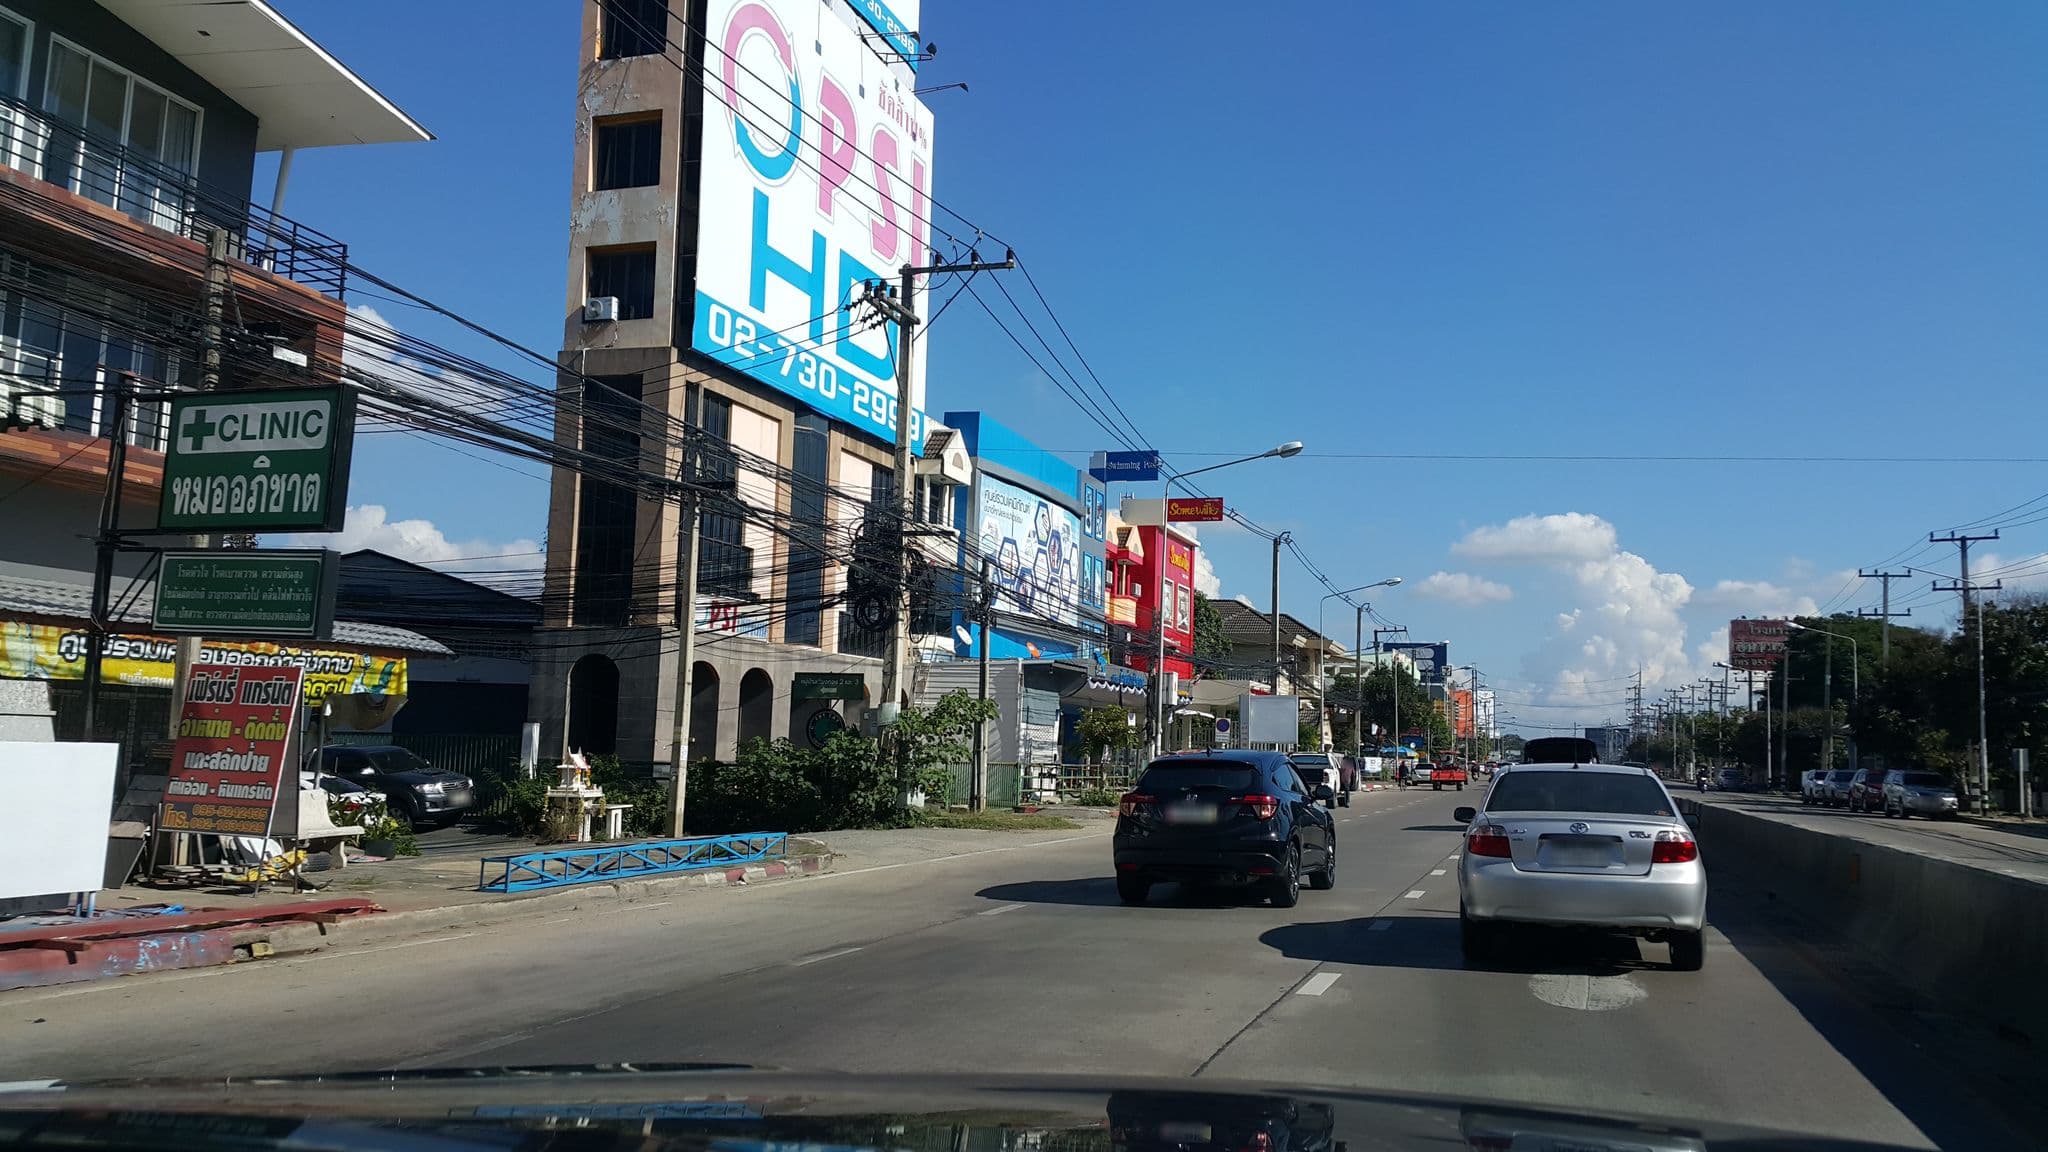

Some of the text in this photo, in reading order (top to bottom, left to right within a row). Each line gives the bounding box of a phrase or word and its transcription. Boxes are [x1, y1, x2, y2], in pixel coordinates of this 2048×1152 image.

[218, 409, 324, 442] CLINIC
[172, 455, 321, 515] หมออภิชาต
[212, 564, 258, 578] โรคเบาหวาน
[240, 675, 296, 706] แกรนิต
[180, 708, 232, 738] จำหน่าย
[244, 708, 287, 741] ติดตั้ง
[217, 780, 273, 800] หินแกรนิต
